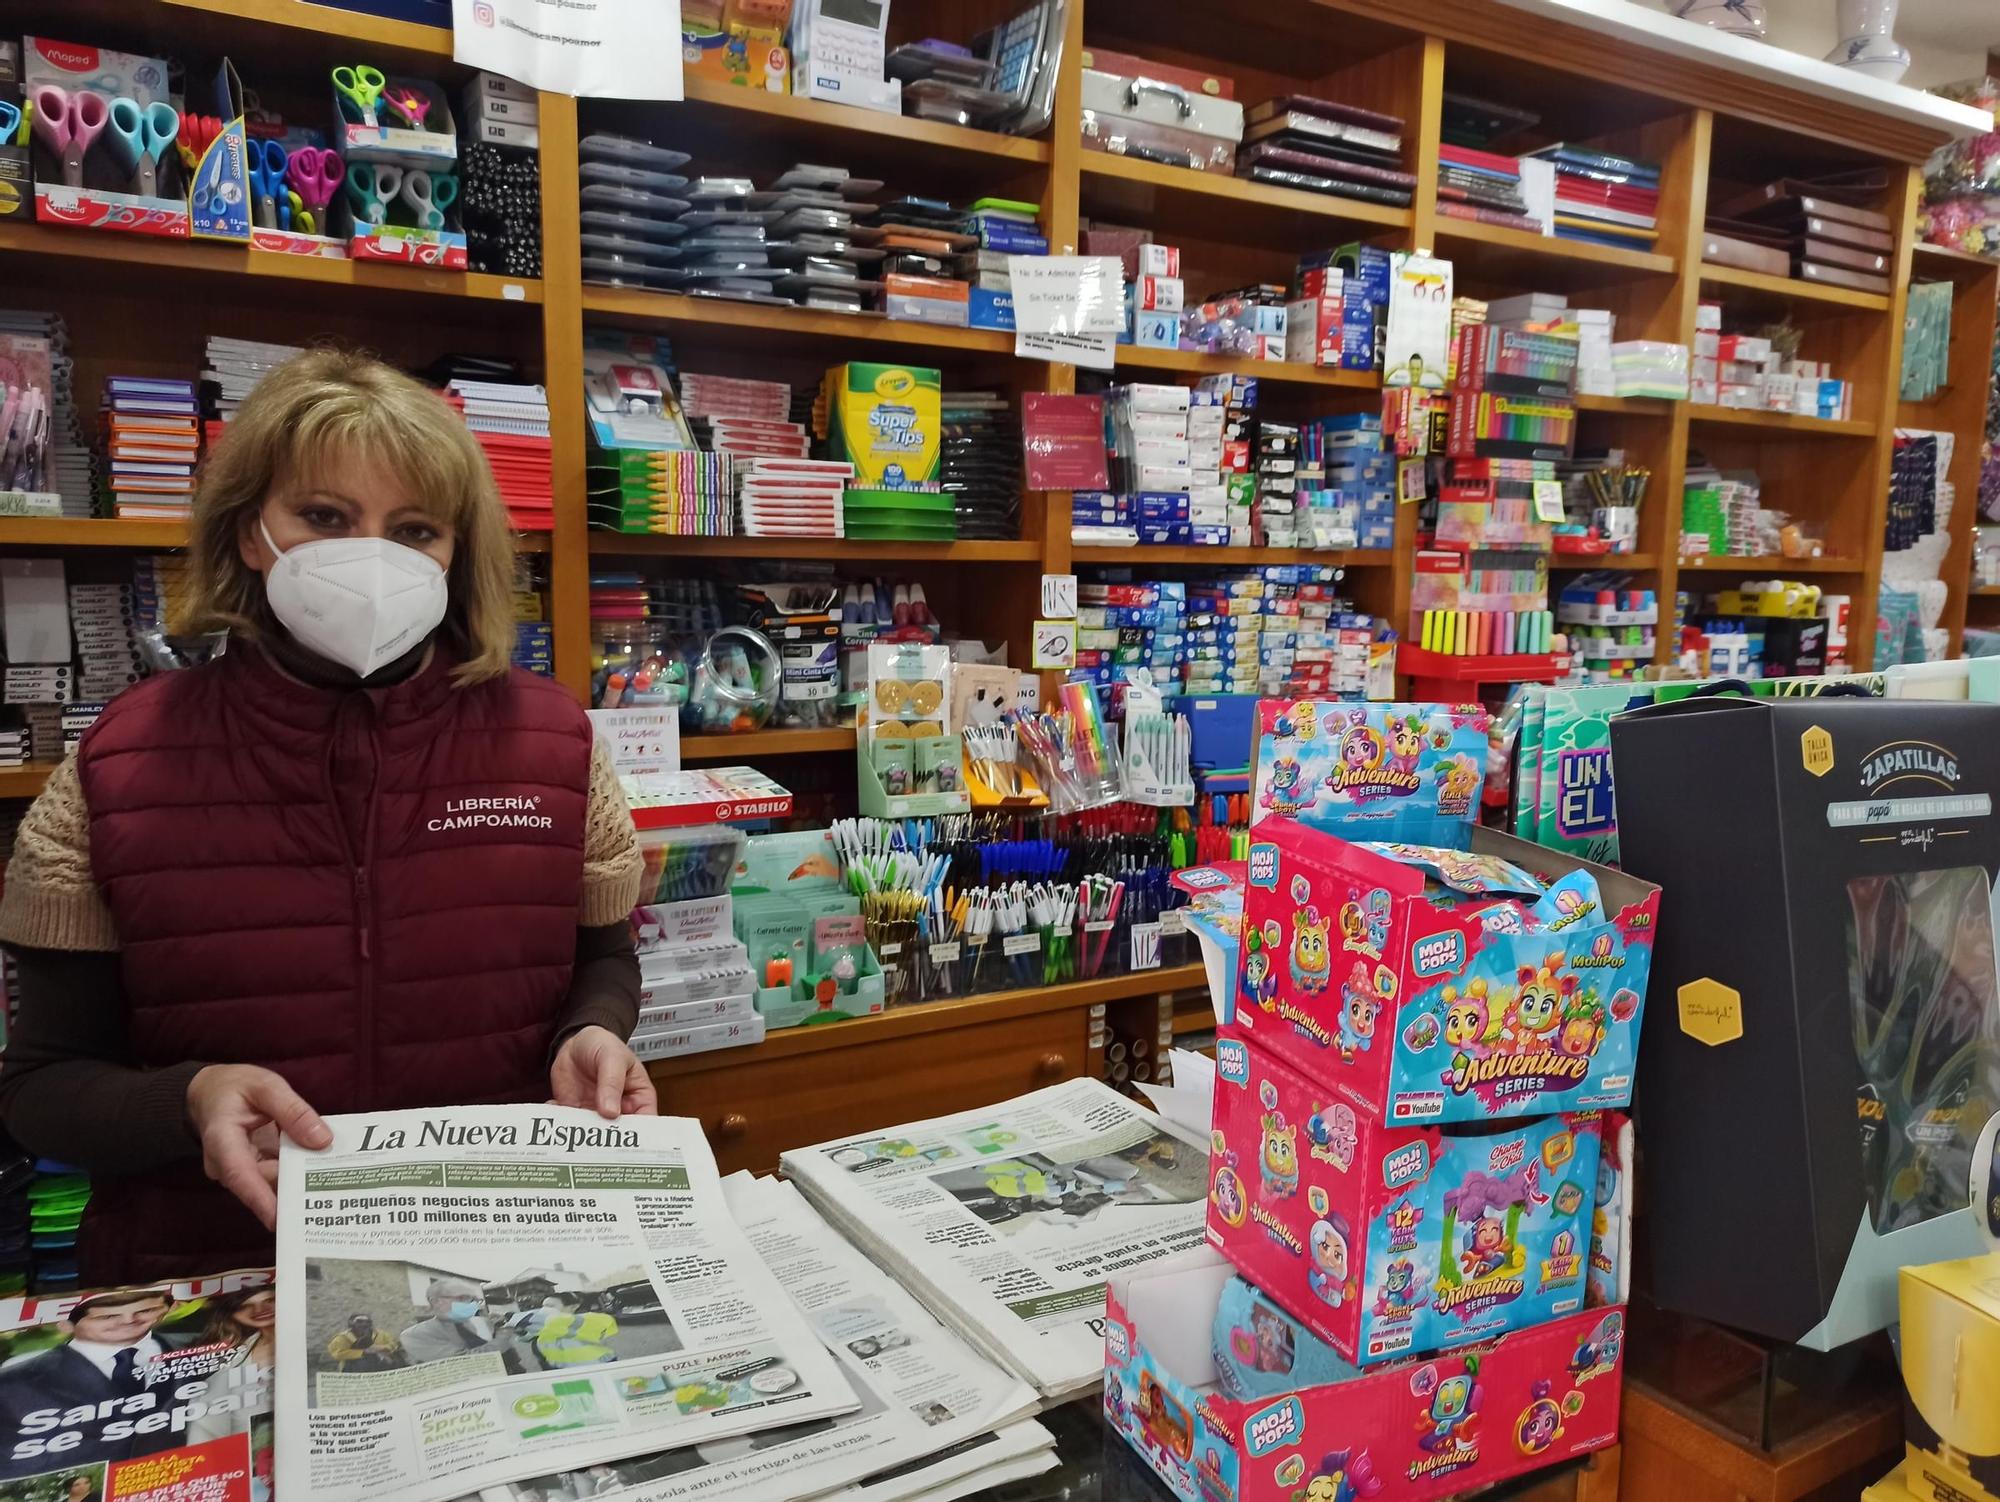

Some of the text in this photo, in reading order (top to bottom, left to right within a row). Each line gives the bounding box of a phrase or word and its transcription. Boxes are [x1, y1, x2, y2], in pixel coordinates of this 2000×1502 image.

[47, 49, 92, 66] Maped
[194, 218, 210, 228] x10
[869, 411, 917, 429] Super
[894, 428, 925, 446] Tips
[1807, 738, 1827, 749] TALLA
[1863, 749, 1957, 787] ZAPATILLAS
[1336, 766, 1421, 794] Adventure
[1359, 785, 1392, 797] SERIES
[733, 800, 790, 816] STABILO
[1562, 788, 1606, 826] EL
[1866, 801, 1893, 823] papá
[427, 814, 553, 832] CAMPOAMOR
[1251, 865, 1274, 880] POPS
[1421, 951, 1458, 972] POPS
[715, 1001, 726, 1014] 36
[728, 1026, 740, 1037] 36
[1279, 1001, 1331, 1046] Adventure
[1221, 1061, 1244, 1075] POPS
[1455, 1049, 1589, 1092] Adventure
[1494, 1076, 1546, 1099] SERIES
[1411, 1102, 1441, 1115] YouTube
[356, 1116, 640, 1153] La Nueva España
[1489, 1138, 1526, 1161] Change
[1390, 1160, 1422, 1182] POPS
[304, 1194, 597, 1211] Los pequeños negocios asturianos se
[304, 1211, 618, 1228] reparten 100 millones en ayuda directa
[1251, 1201, 1303, 1255] Adventure
[1393, 1208, 1413, 1228] 12
[1443, 1276, 1525, 1312] Adventure
[1465, 1295, 1497, 1313] SERIES
[153, 1342, 227, 1362] EXCLUSIVA
[1383, 1337, 1411, 1350] YouTube
[170, 1344, 247, 1367] FAMILIAS
[662, 1358, 700, 1373] PUZLE
[151, 1358, 220, 1377] AMIGOS
[151, 1362, 231, 1384] LO SABEN
[17, 1380, 209, 1436] Sara e
[308, 1409, 386, 1421] Los profesores
[421, 1409, 487, 1434] Spray
[1254, 1419, 1296, 1451] POPS
[10, 1430, 84, 1461] se
[689, 1475, 722, 1492] ante
[792, 1450, 808, 1463] de
[810, 1443, 832, 1459] las
[832, 1432, 872, 1451] urnas
[1409, 1446, 1480, 1481] Adventure
[1430, 1464, 1459, 1479] SERIES
[222, 1470, 245, 1480] NO
